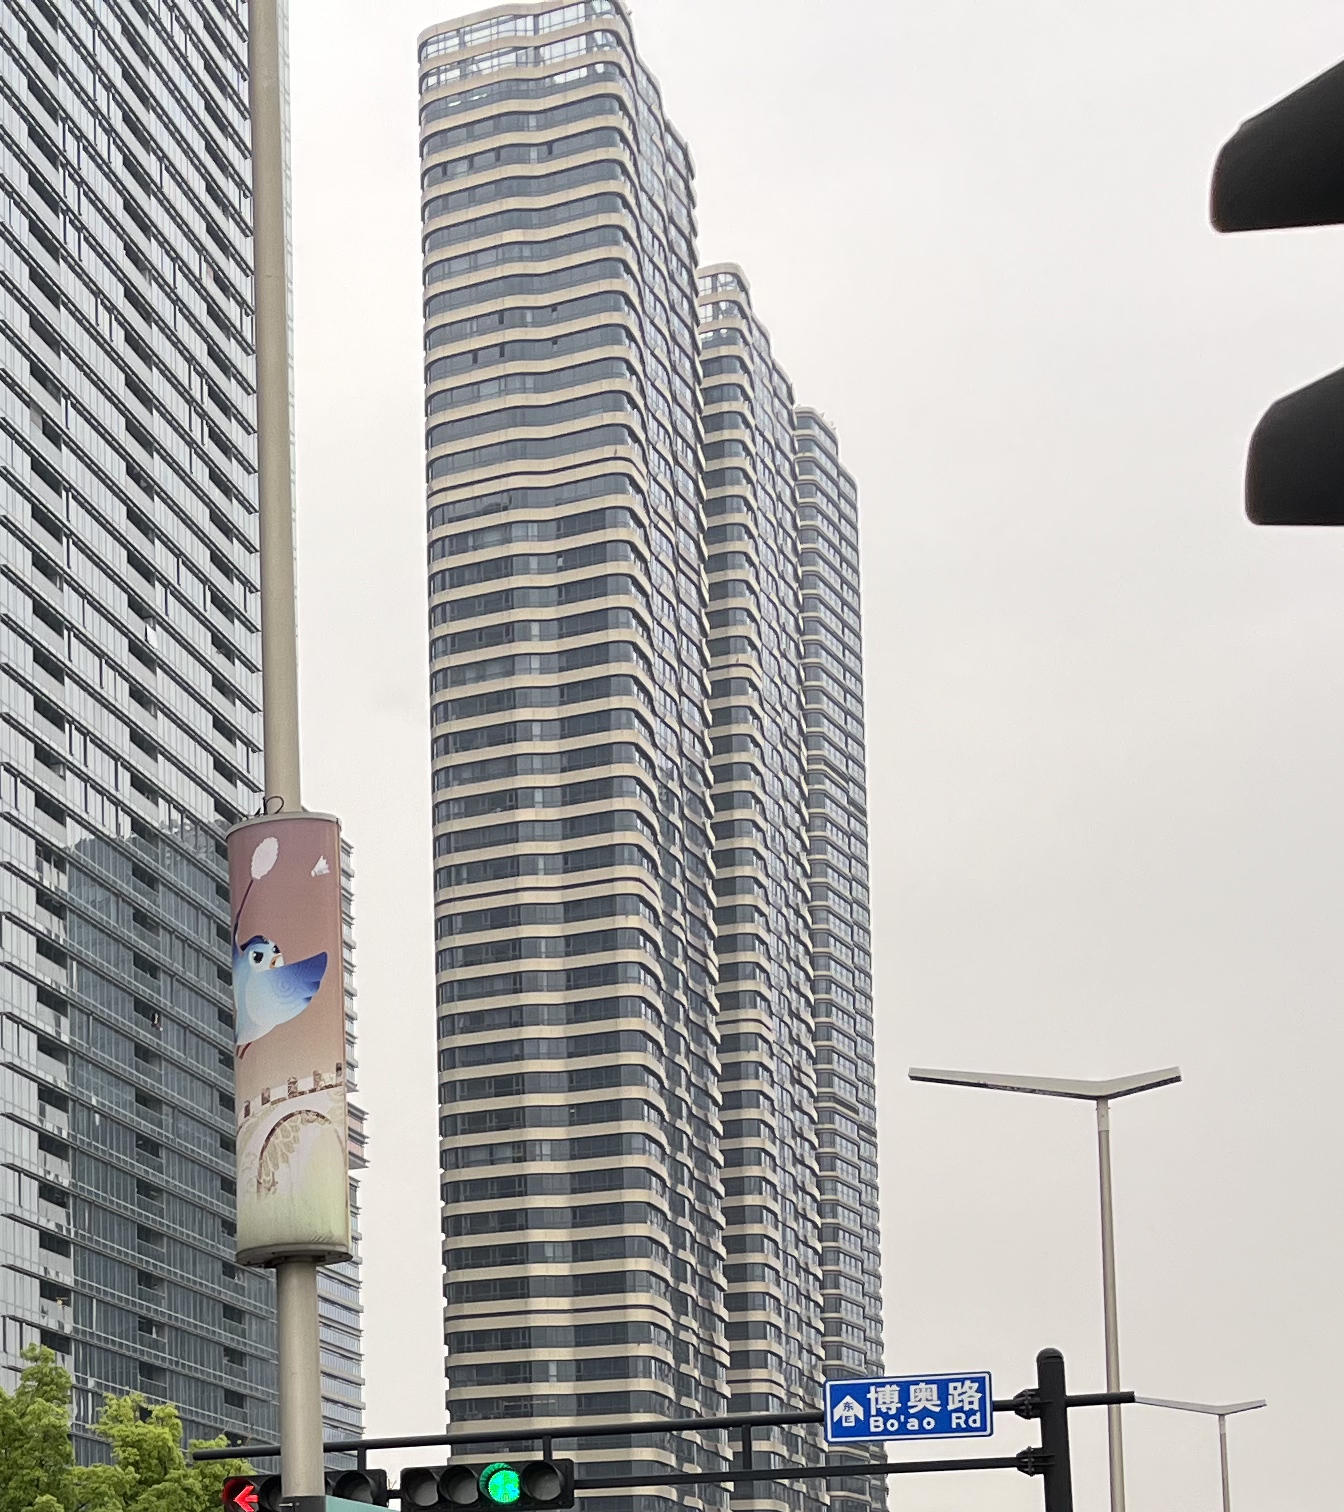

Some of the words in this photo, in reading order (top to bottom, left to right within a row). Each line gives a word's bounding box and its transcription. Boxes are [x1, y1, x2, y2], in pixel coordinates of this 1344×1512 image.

[843, 1401, 854, 1412] 东
[866, 1380, 982, 1415] 博奥路
[869, 1414, 936, 1432] Bo'ao
[951, 1411, 982, 1429] Rd
